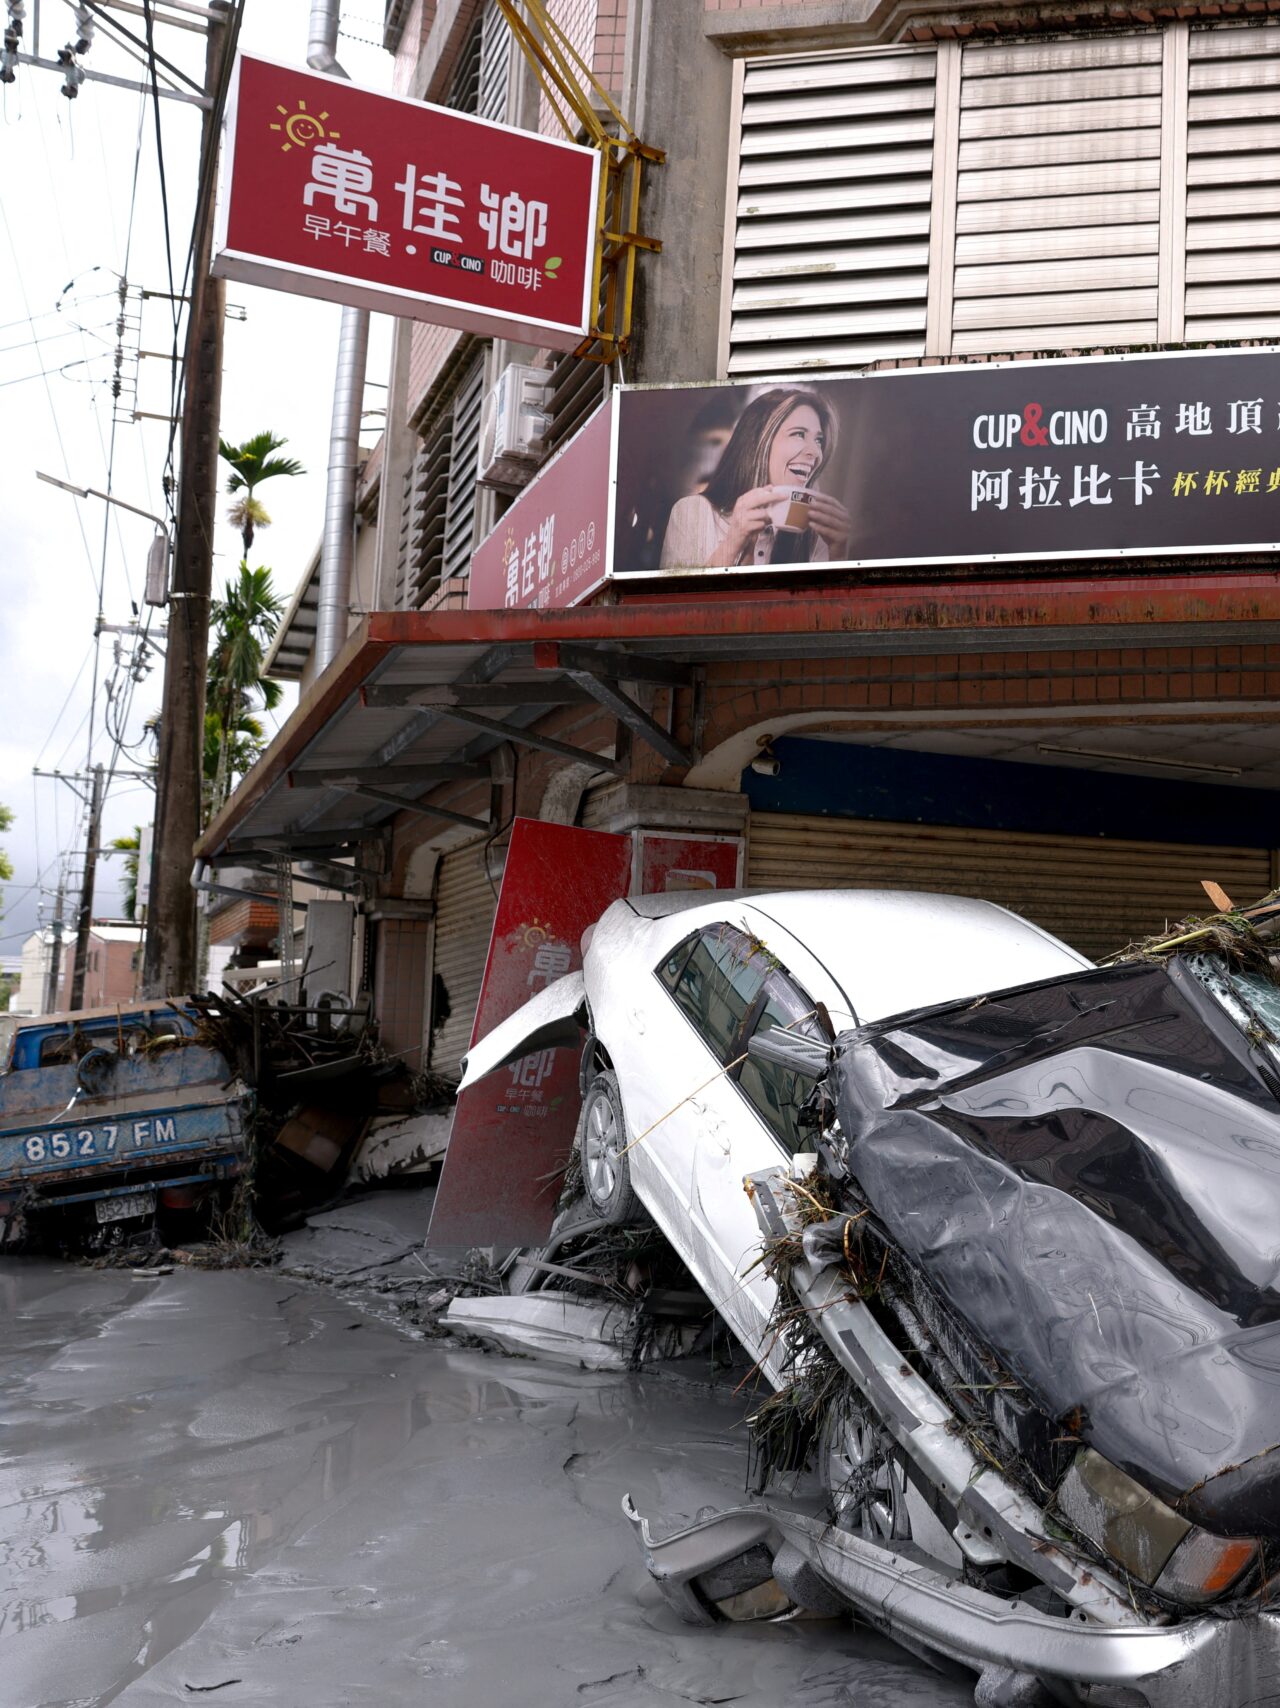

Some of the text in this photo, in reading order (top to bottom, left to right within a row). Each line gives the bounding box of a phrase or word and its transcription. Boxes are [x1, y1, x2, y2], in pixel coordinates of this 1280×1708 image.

[303, 142, 548, 260] 萬佳鄉
[302, 213, 391, 257] 早午餐
[490, 259, 542, 291] 咖啡
[973, 402, 1108, 449] CUP&CINO
[971, 460, 1161, 511] 阿拉比卡
[505, 513, 555, 608] 萬佳鄉
[508, 942, 572, 1087] 萬鄉
[26, 1118, 176, 1162] 8527 FM
